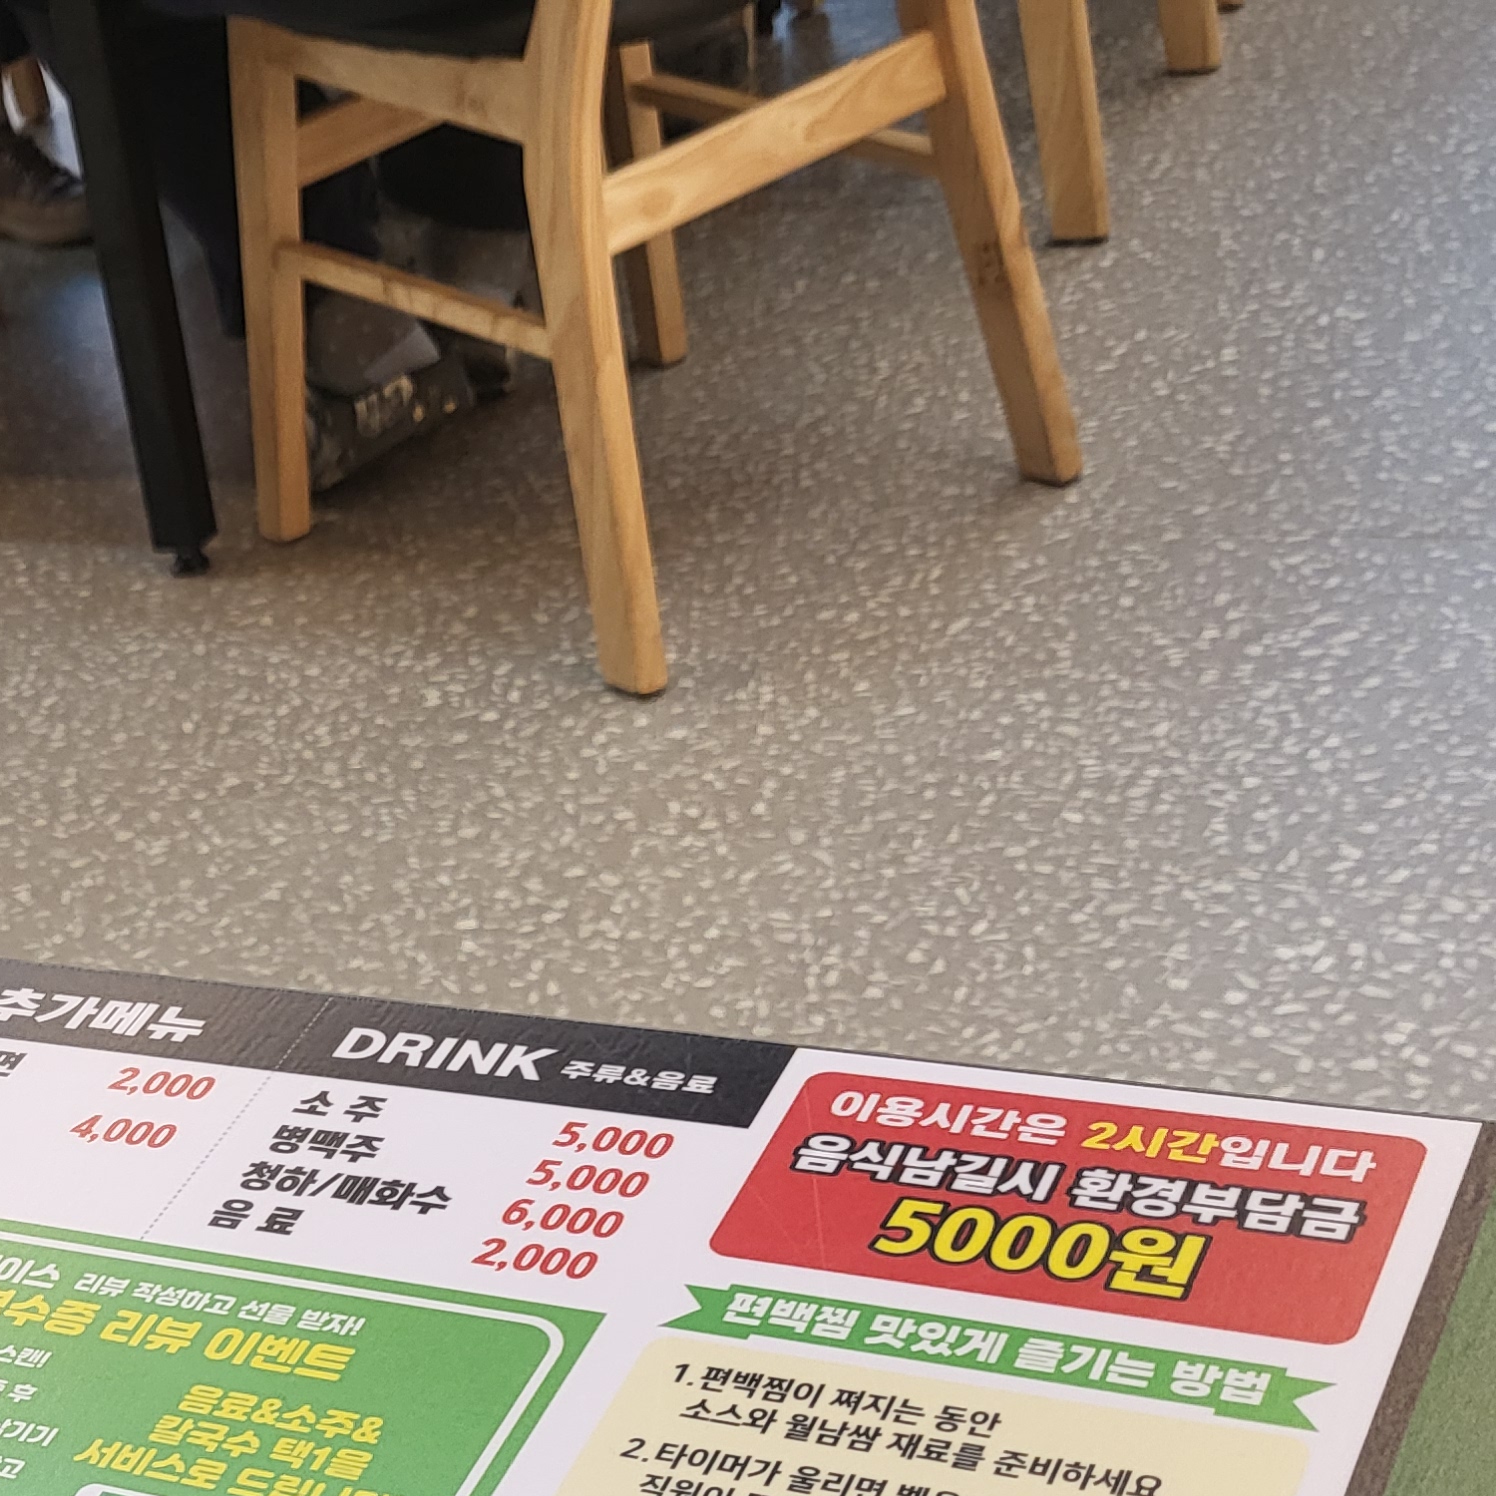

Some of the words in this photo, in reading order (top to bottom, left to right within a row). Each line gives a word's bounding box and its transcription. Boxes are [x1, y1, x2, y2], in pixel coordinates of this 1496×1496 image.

[107, 1066, 216, 1101] 2,000
[330, 1026, 559, 1083] DRINK
[560, 1059, 720, 1095] 주류&음료
[69, 1114, 178, 1149] 4,000
[268, 1123, 386, 1164] 병맥주
[526, 1158, 651, 1200] 5,000
[552, 1121, 675, 1160] 5,000
[828, 1088, 1067, 1146] 이용시간은
[1081, 1120, 1378, 1184] 2시간입니다
[239, 1160, 454, 1216] 청하/매화수
[501, 1198, 626, 1240] 6,000
[791, 1133, 1058, 1202] 음식남길시
[1070, 1166, 1366, 1243] 환경부담금
[471, 1236, 599, 1281] 2,000
[870, 1199, 1210, 1301] 5000원
[74, 1272, 132, 1297] 리뷰
[131, 1282, 237, 1316] 작성하고
[236, 1299, 293, 1326] 선물
[290, 1308, 367, 1337] 받자!
[99, 1308, 203, 1354] 리뷰
[203, 1326, 356, 1381] 이벤트
[723, 1290, 859, 1341] 편백찜
[867, 1315, 1009, 1364] 맛있게
[1017, 1341, 1158, 1391] 즐기는
[1169, 1362, 1273, 1407] 방법
[7, 1383, 39, 1403] 후
[177, 1384, 385, 1445] 음료&소주&
[700, 1366, 826, 1409] 편백찜이
[933, 1405, 1002, 1439] 동안
[73, 1438, 228, 1491] 서비스로
[147, 1414, 261, 1458] 칼국수
[269, 1437, 374, 1482] 택1을
[653, 1442, 784, 1488] 타이머가
[678, 1398, 779, 1435] 소스와
[783, 1412, 883, 1453] 월남쌈
[885, 1432, 986, 1472] 재료를
